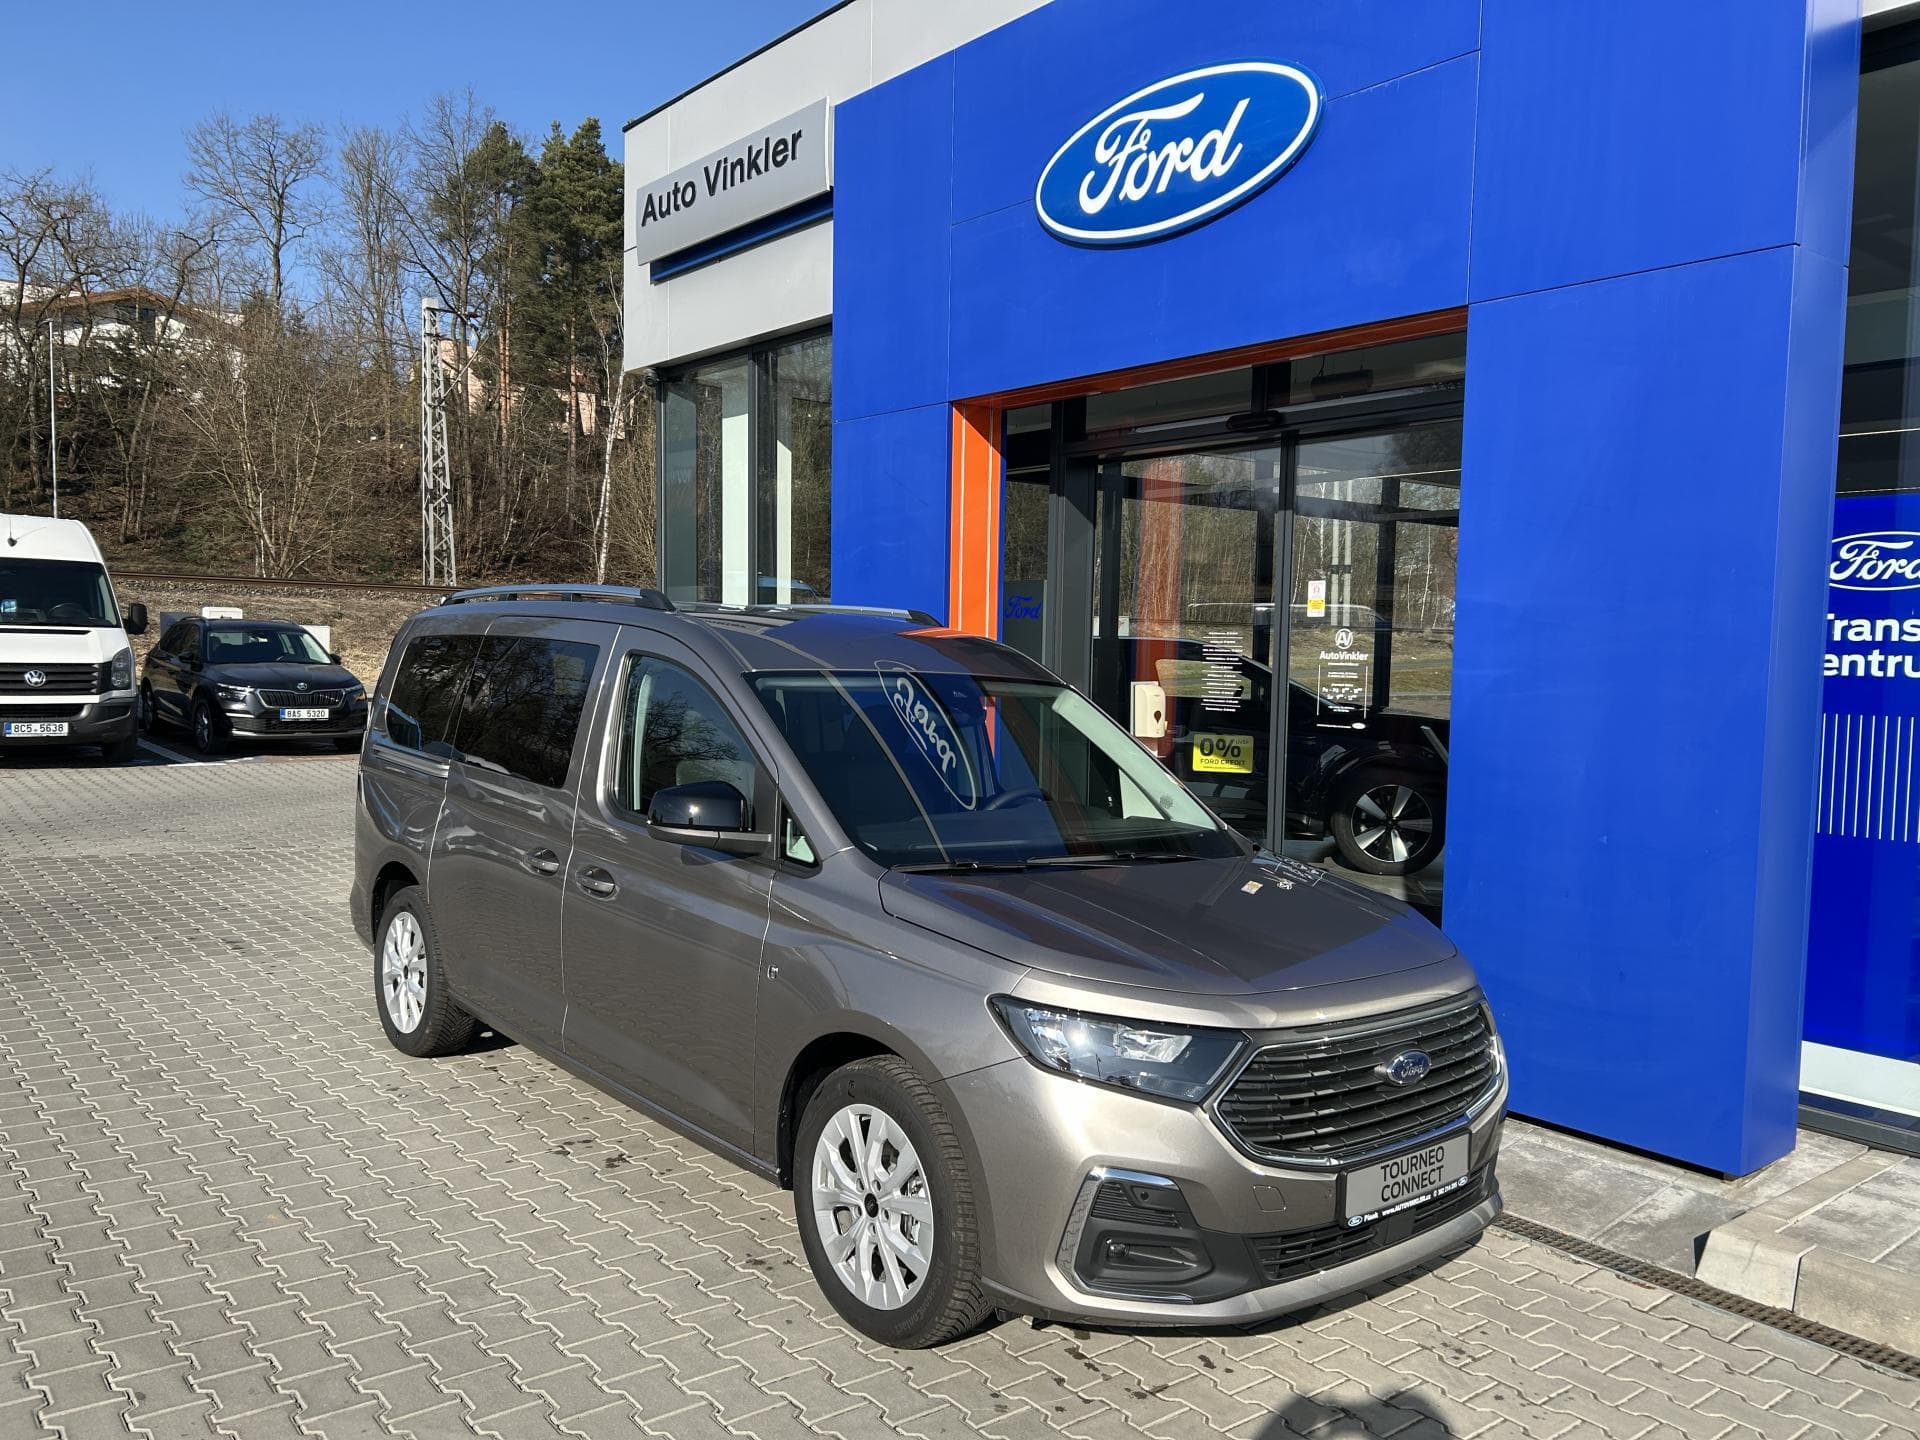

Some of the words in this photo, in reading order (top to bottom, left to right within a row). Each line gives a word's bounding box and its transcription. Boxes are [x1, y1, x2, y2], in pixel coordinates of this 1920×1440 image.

[1079, 92, 1250, 215] Ford
[641, 180, 697, 228] Auto
[703, 129, 803, 197] Vinkler
[1319, 650, 1369, 661] AutoVinkler
[39, 724, 64, 733] 5638
[1200, 737, 1241, 758] 0%
[1380, 1146, 1445, 1182] TOURNEO
[1381, 1164, 1444, 1202] CONNECT
